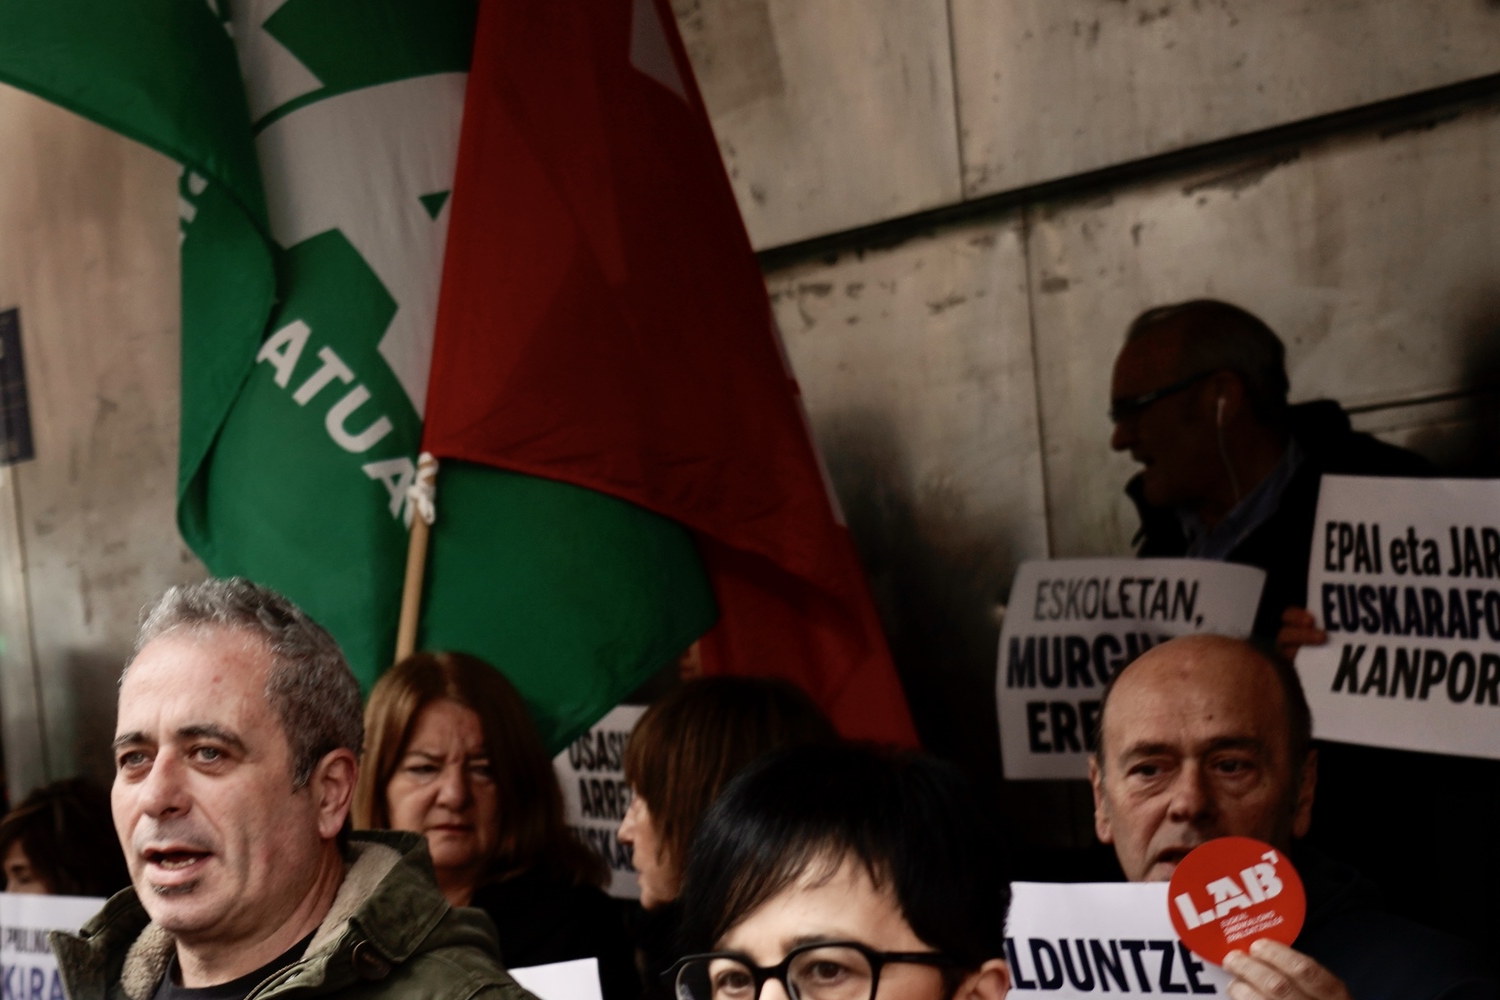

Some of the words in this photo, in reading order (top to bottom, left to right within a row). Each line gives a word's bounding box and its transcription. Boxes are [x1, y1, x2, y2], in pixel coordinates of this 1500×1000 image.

[1325, 521, 1382, 574] EPAI
[1390, 526, 1441, 576] eta
[1033, 576, 1204, 628] ESKOLETAN,
[1174, 859, 1283, 931] LAB
[1006, 937, 1217, 994] LDUNTZE
